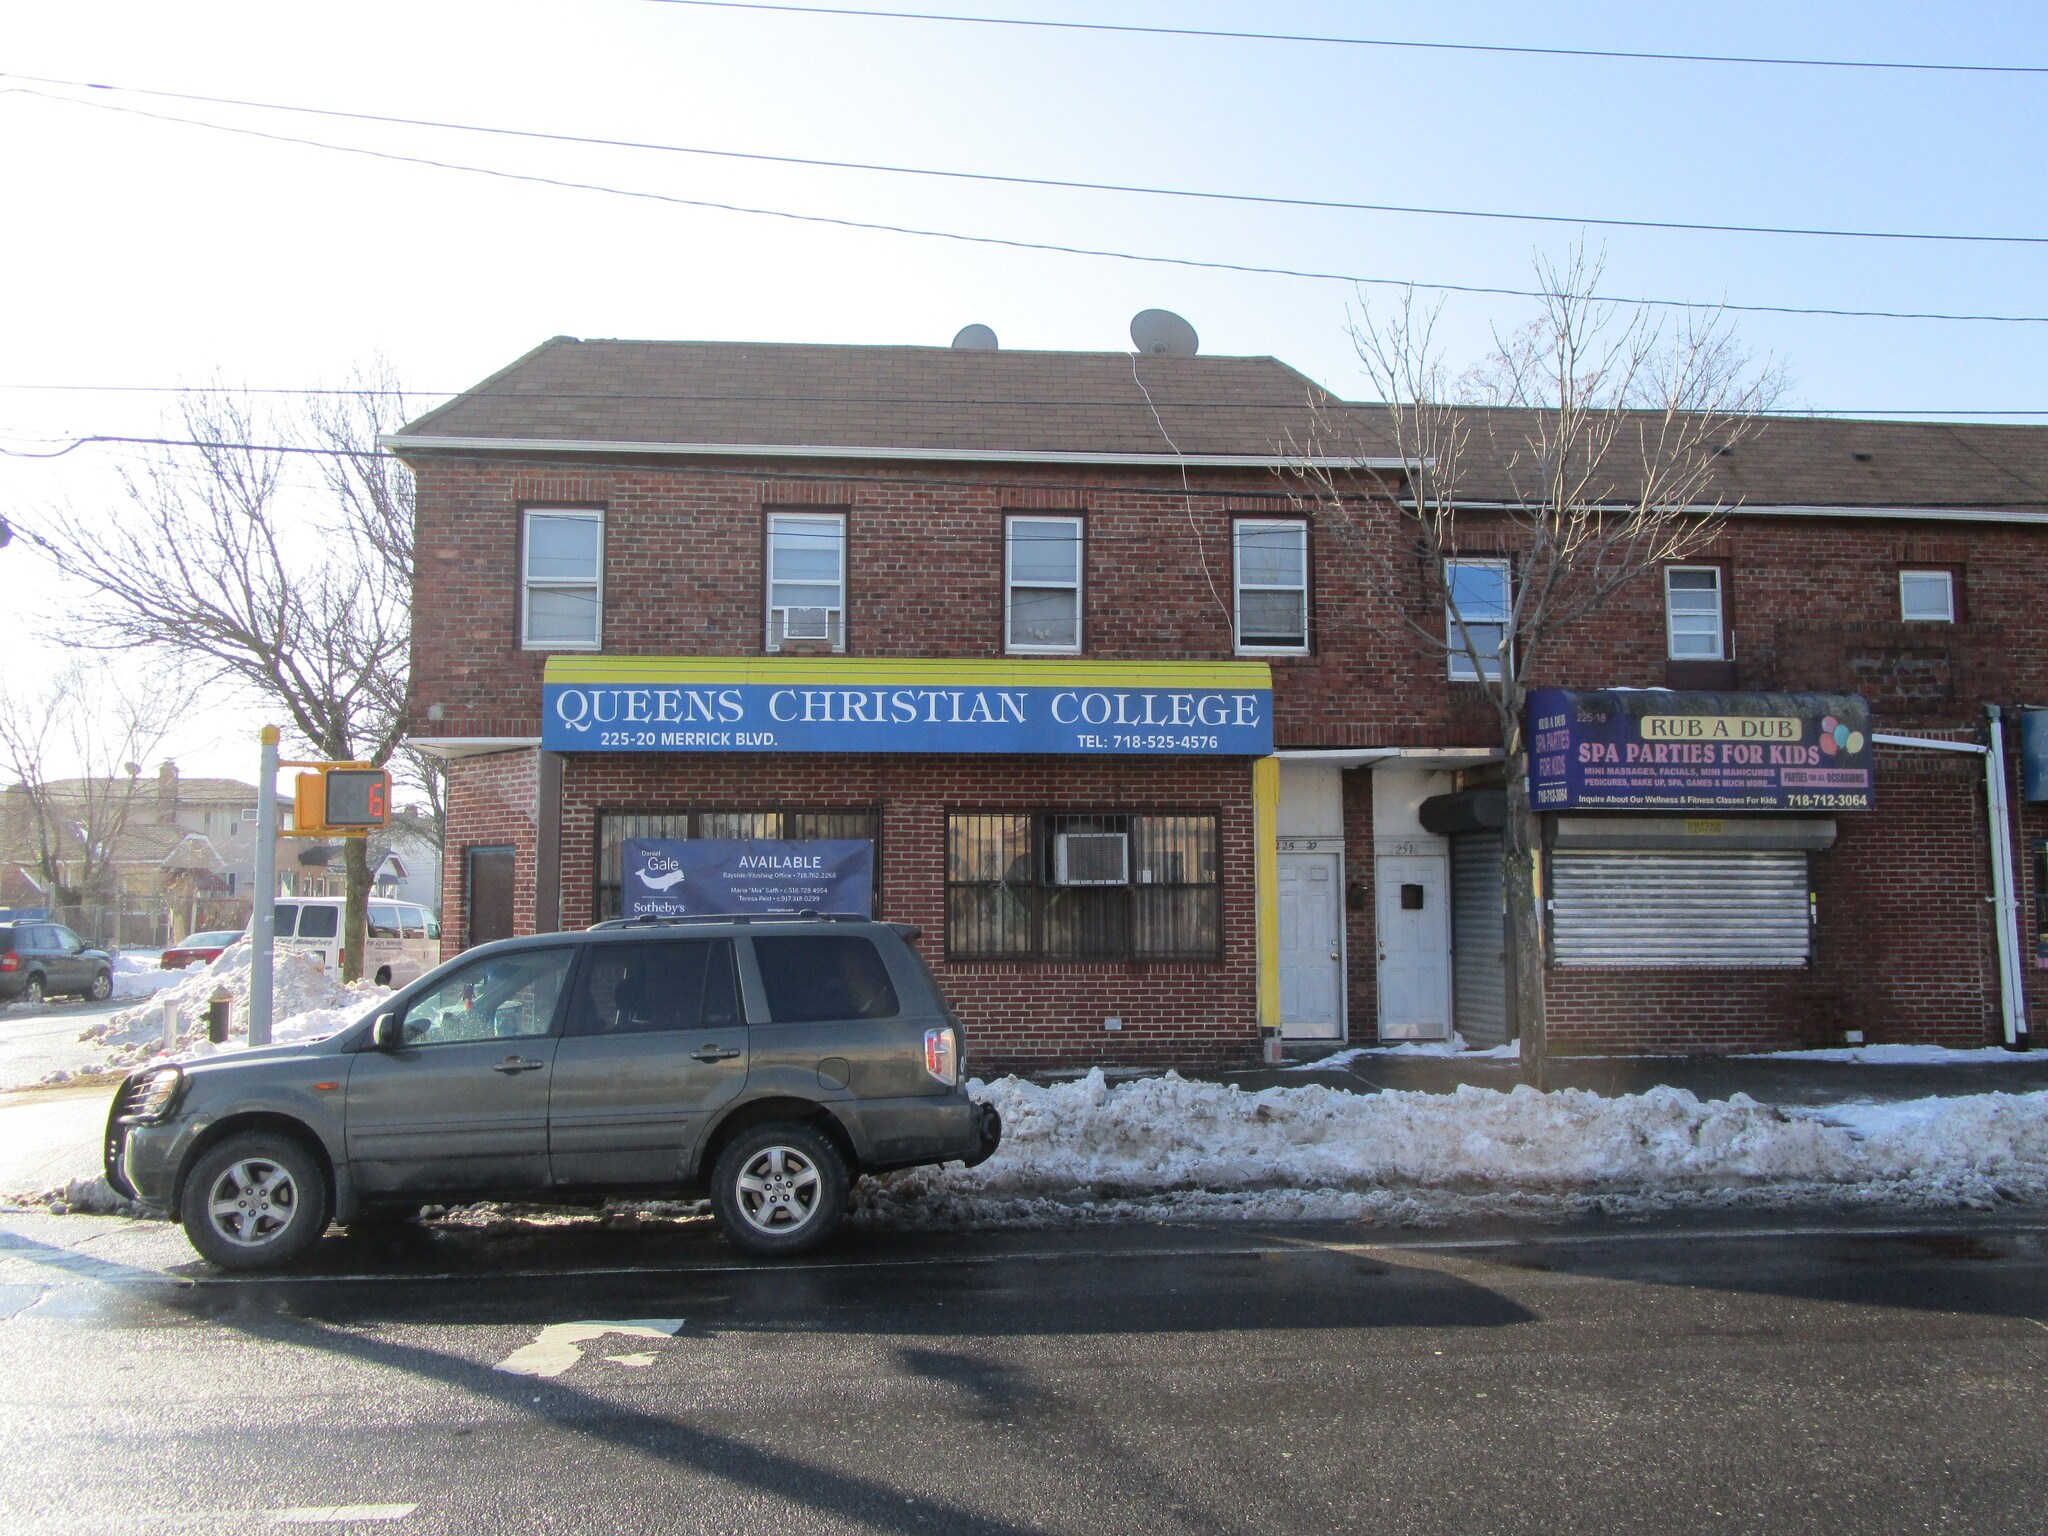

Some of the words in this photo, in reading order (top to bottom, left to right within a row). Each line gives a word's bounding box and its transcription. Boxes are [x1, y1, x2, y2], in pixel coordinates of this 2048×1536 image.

[556, 688, 744, 732] QUEENS
[768, 688, 1029, 724] CHRISTIAN
[1051, 691, 1261, 728] COLLEGE
[1538, 717, 1549, 730] RUB
[1550, 716, 1554, 728] A
[1554, 714, 1566, 727] DUB
[1576, 713, 1607, 723] 225-18
[1651, 718, 1704, 738] RUB
[1712, 719, 1729, 737] A
[1740, 720, 1794, 739] DUB
[600, 732, 656, 746] 225-20
[661, 732, 731, 746] MERRICK
[735, 733, 778, 746] BLVD.
[1077, 734, 1108, 749] TEL:
[1113, 735, 1218, 749] 718-525-4576
[1535, 733, 1547, 754] SPA
[1546, 729, 1570, 752] PARTIES
[1578, 742, 1620, 763] SPA
[1626, 743, 1715, 764] PARTIES
[1722, 743, 1763, 765] FOR
[1769, 745, 1820, 765] KIDS
[1539, 757, 1551, 776] FOR
[1552, 755, 1566, 775] KIDS
[1584, 767, 1605, 775] MINI
[1607, 767, 1657, 776] MASSAGES,
[1659, 768, 1699, 777] FACIALS,
[1701, 768, 1721, 776] MINI
[1723, 769, 1776, 777] MANICURES
[1584, 778, 1630, 788] PEDICURES,
[1631, 779, 1653, 787] MAKE
[1654, 779, 1667, 788] UP,
[1668, 779, 1685, 788] SPA,
[1686, 779, 1713, 787] GAMES
[1714, 779, 1721, 787] &
[1722, 779, 1745, 787] MUCH
[1784, 772, 1808, 783] PARTIES
[1826, 772, 1865, 784] OCCASIONS
[369, 783, 383, 816] 6
[1578, 795, 1605, 804] Inquire
[1606, 795, 1629, 803] About
[1645, 796, 1679, 804] Wellness
[1687, 796, 1715, 804] Fitness
[1716, 796, 1745, 804] Classes
[1746, 796, 1760, 804] For
[1760, 796, 1778, 804] Kids
[1787, 794, 1868, 806] 718-712-3064
[647, 856, 679, 871] Gale
[738, 855, 822, 869] AVAILABLE
[722, 872, 774, 880] Bayside/Flushing
[633, 901, 685, 915] Sotheby's
